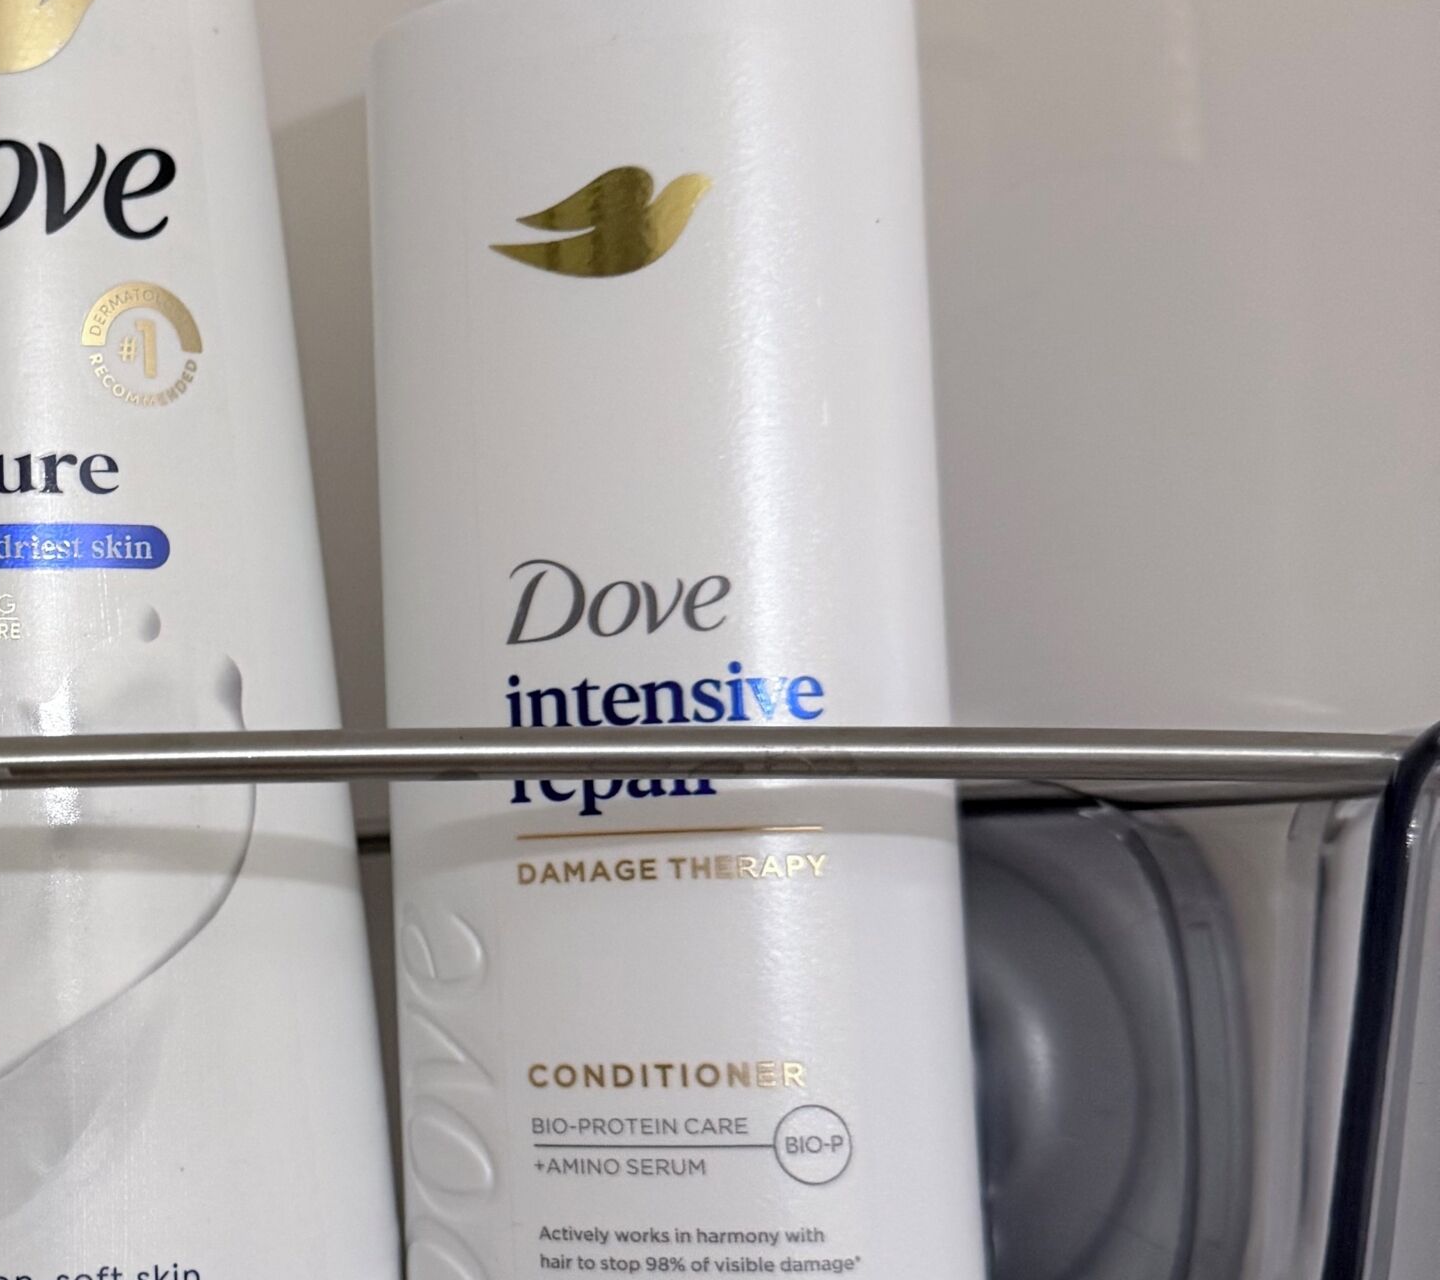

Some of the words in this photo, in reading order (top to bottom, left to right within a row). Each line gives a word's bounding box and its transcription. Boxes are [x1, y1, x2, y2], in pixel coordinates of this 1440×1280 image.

[118, 320, 157, 378] #1
[88, 352, 198, 407] RECOMMENDED
[91, 533, 153, 560] skin
[506, 557, 731, 645] Dove
[505, 660, 824, 727] intensive
[517, 859, 658, 885] DAMAGE
[668, 853, 827, 880] THERAPY
[527, 1061, 808, 1088] CONDITIONER
[531, 1117, 678, 1135] BIO-PROTEIN
[684, 1117, 749, 1135] CARE
[785, 1135, 844, 1154] BIO-P
[534, 1158, 620, 1176] +AMINO
[626, 1158, 707, 1176] SERUM
[539, 1226, 609, 1245] Actively
[614, 1227, 670, 1243] works
[675, 1227, 691, 1243] in
[696, 1227, 779, 1246] harmony
[784, 1227, 825, 1243] with
[539, 1254, 573, 1270] hair
[577, 1256, 596, 1270] to
[600, 1257, 641, 1274] stop
[645, 1256, 686, 1271] 98%
[690, 1256, 711, 1271] of
[714, 1256, 775, 1272] visible
